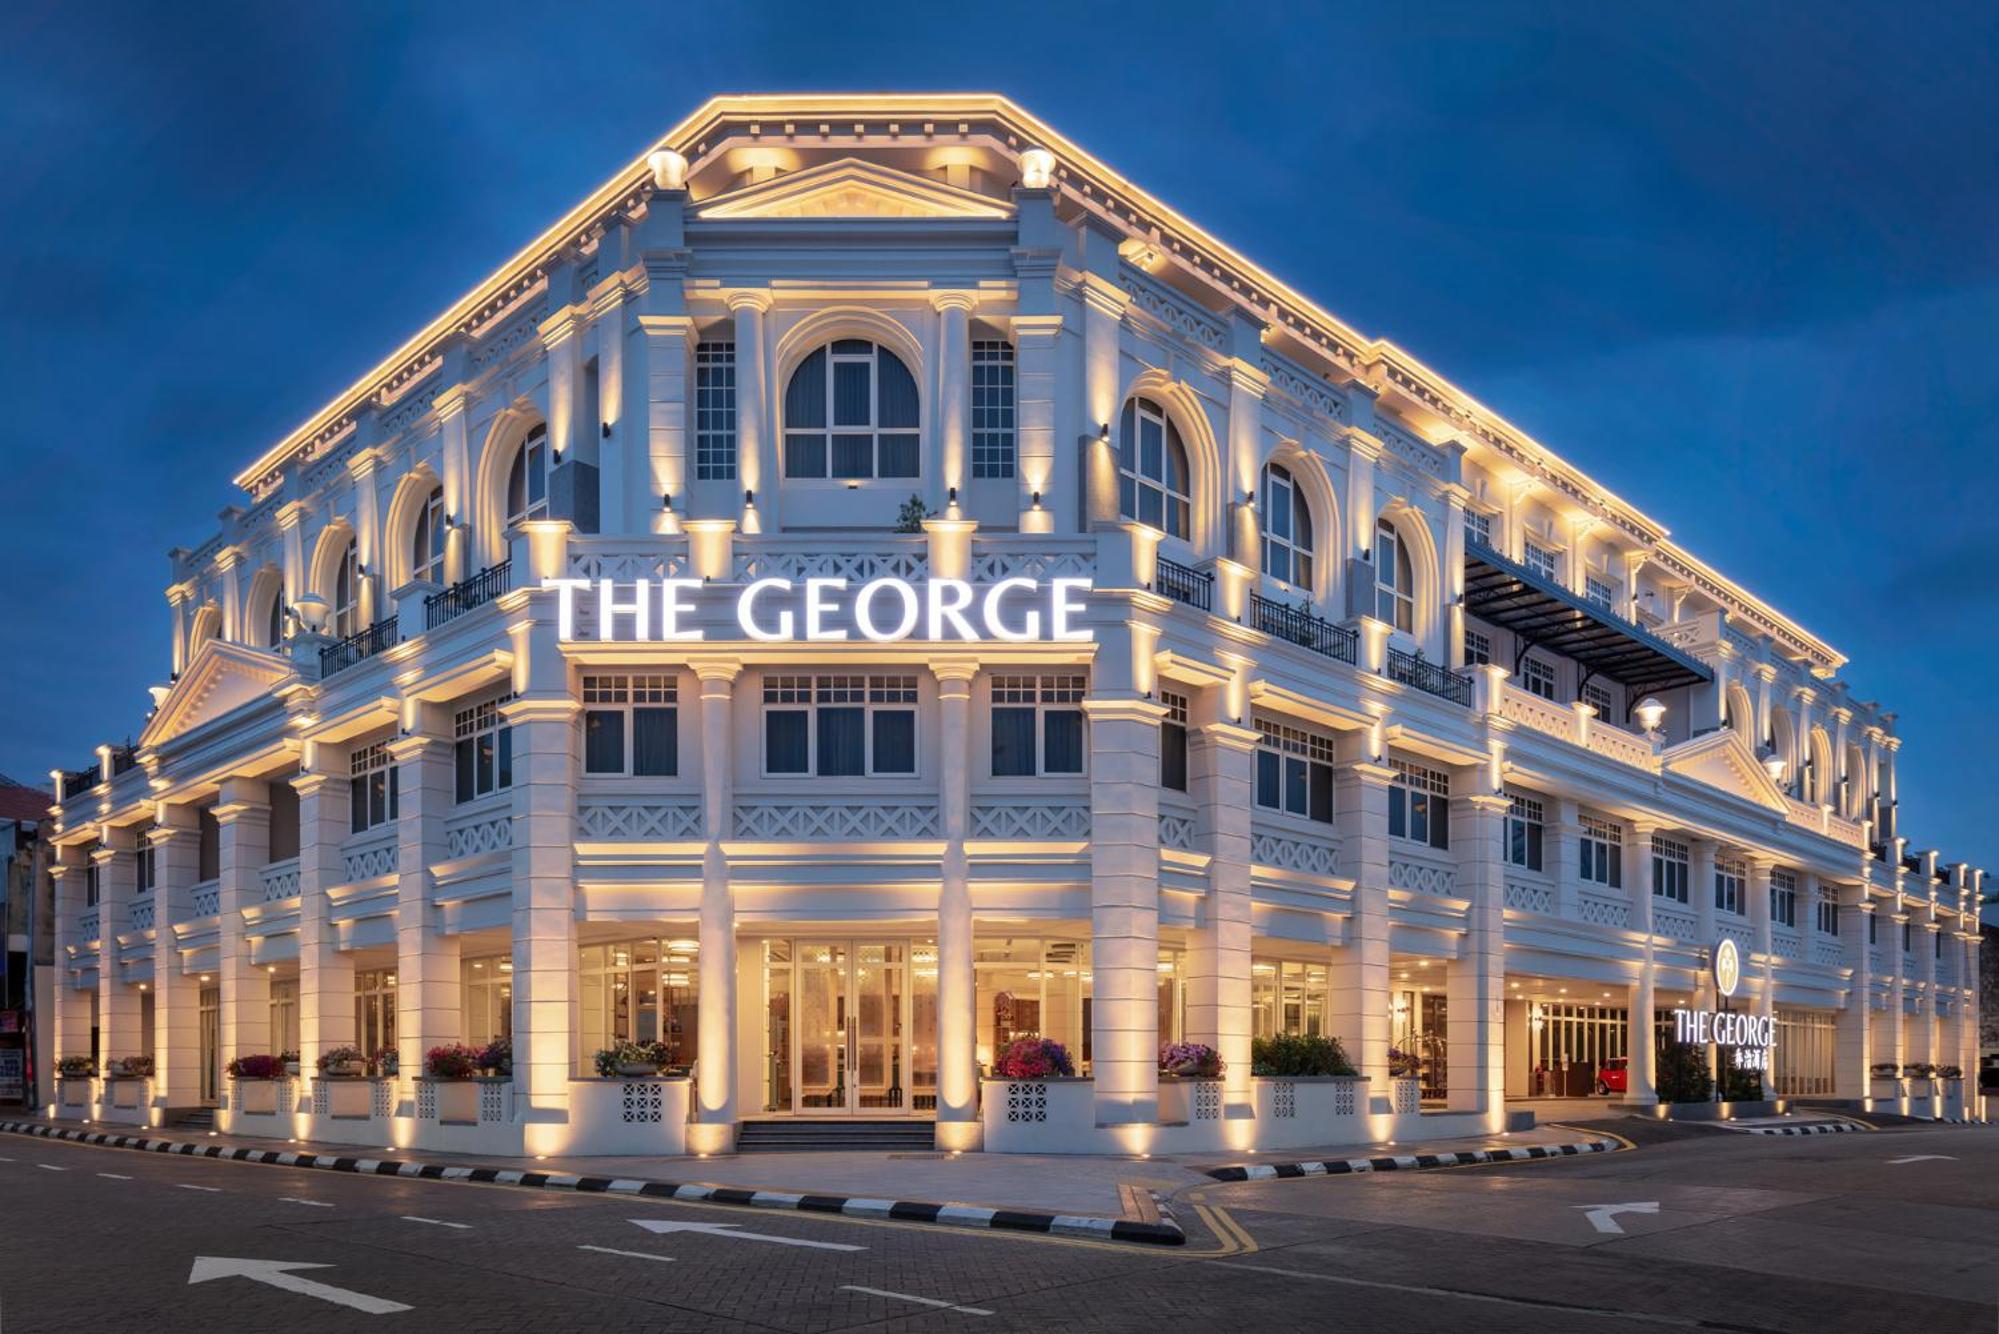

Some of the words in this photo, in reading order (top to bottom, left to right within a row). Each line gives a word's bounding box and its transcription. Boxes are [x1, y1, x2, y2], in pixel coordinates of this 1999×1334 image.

[541, 578, 704, 642] THE
[737, 578, 1094, 642] GEORGE
[1674, 1010, 1708, 1043] THE
[1713, 1013, 1777, 1046] GEORGE
